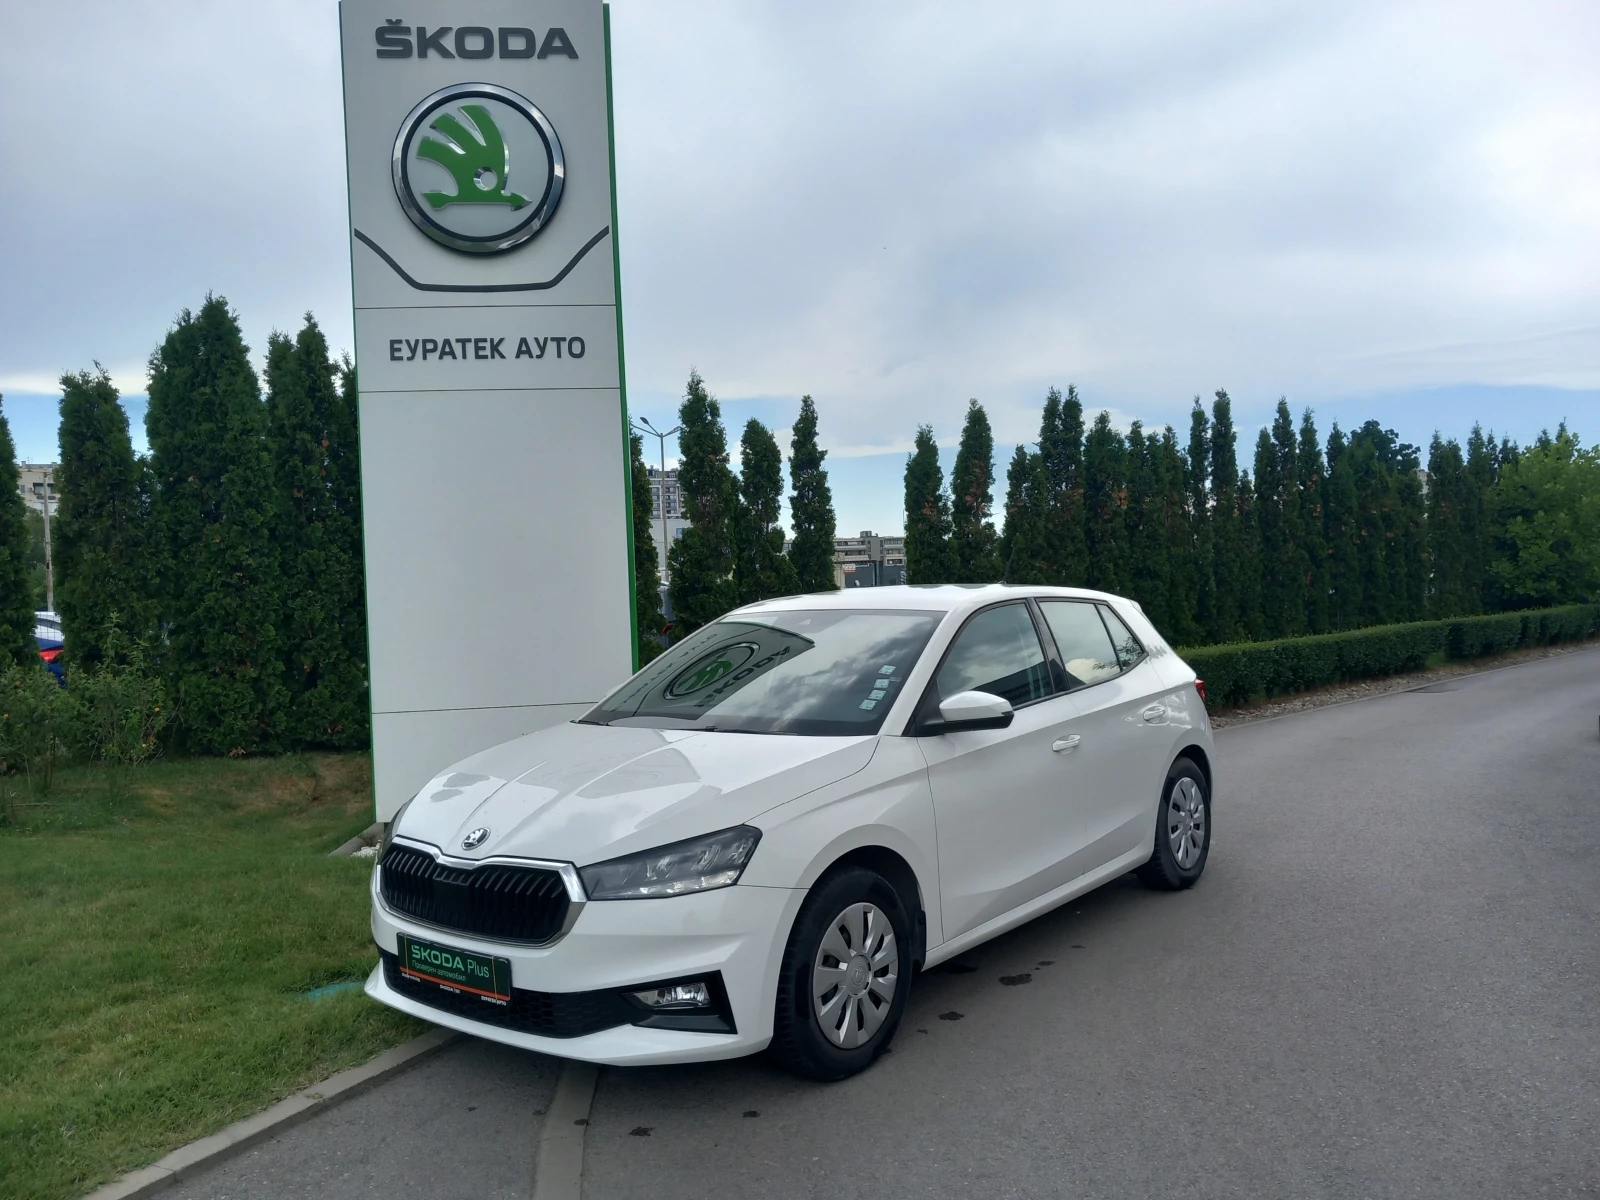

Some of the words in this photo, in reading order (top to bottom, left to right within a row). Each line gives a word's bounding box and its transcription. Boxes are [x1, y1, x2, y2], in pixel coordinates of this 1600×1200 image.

[375, 19, 579, 59] ŠKODA
[389, 337, 506, 361] ЕУРАТЕК
[515, 336, 586, 360] АУТО
[467, 959, 490, 978] Plus
